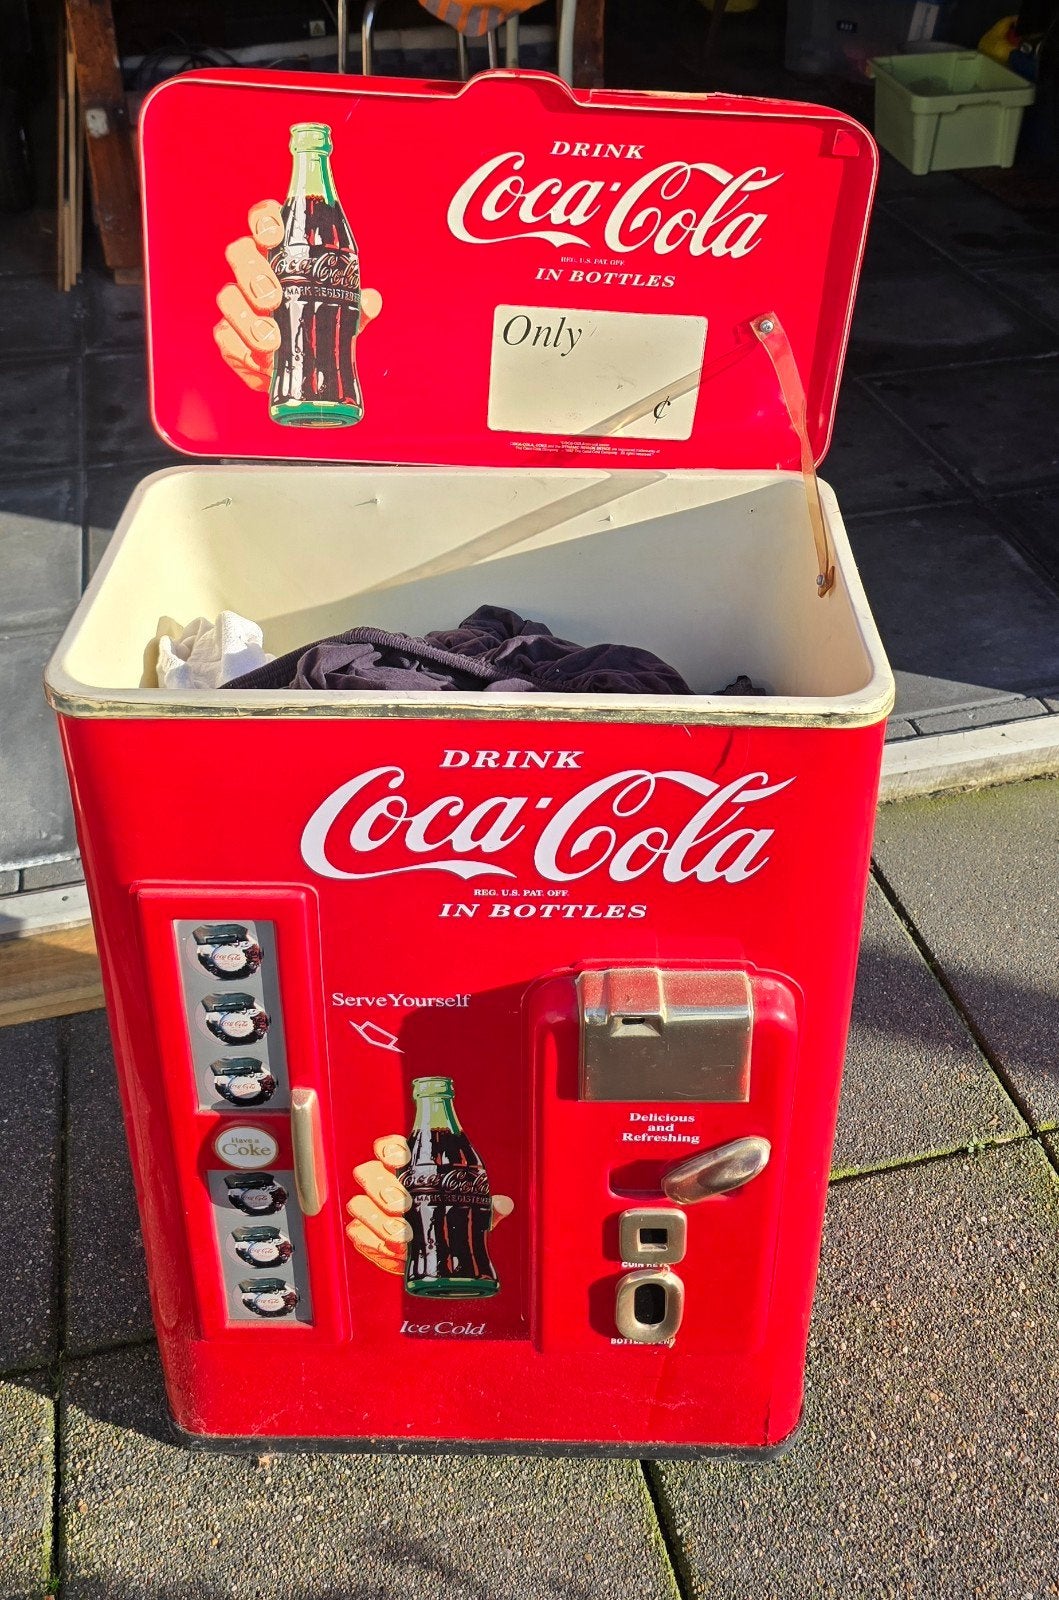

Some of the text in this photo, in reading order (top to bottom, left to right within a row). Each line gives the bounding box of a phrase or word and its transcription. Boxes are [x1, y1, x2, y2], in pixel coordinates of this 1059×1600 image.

[550, 140, 645, 160] DRINK
[447, 151, 785, 259] Coca-Cola
[535, 267, 676, 288] IN BOTTLES
[503, 313, 585, 357] Only
[439, 749, 585, 769] DRINK
[300, 766, 797, 883] Coca-Cola
[473, 888, 498, 897] REG.
[501, 889, 521, 897] U.S.
[523, 889, 544, 897] PAT.
[438, 903, 647, 919] IN BOTTLES
[331, 992, 472, 1008] Serve Yourself
[629, 1112, 695, 1122] Delicious
[647, 1123, 675, 1132] and
[622, 1132, 700, 1144] Refreshing
[221, 1143, 272, 1155] Coke
[399, 1320, 487, 1335] Ice Cold
